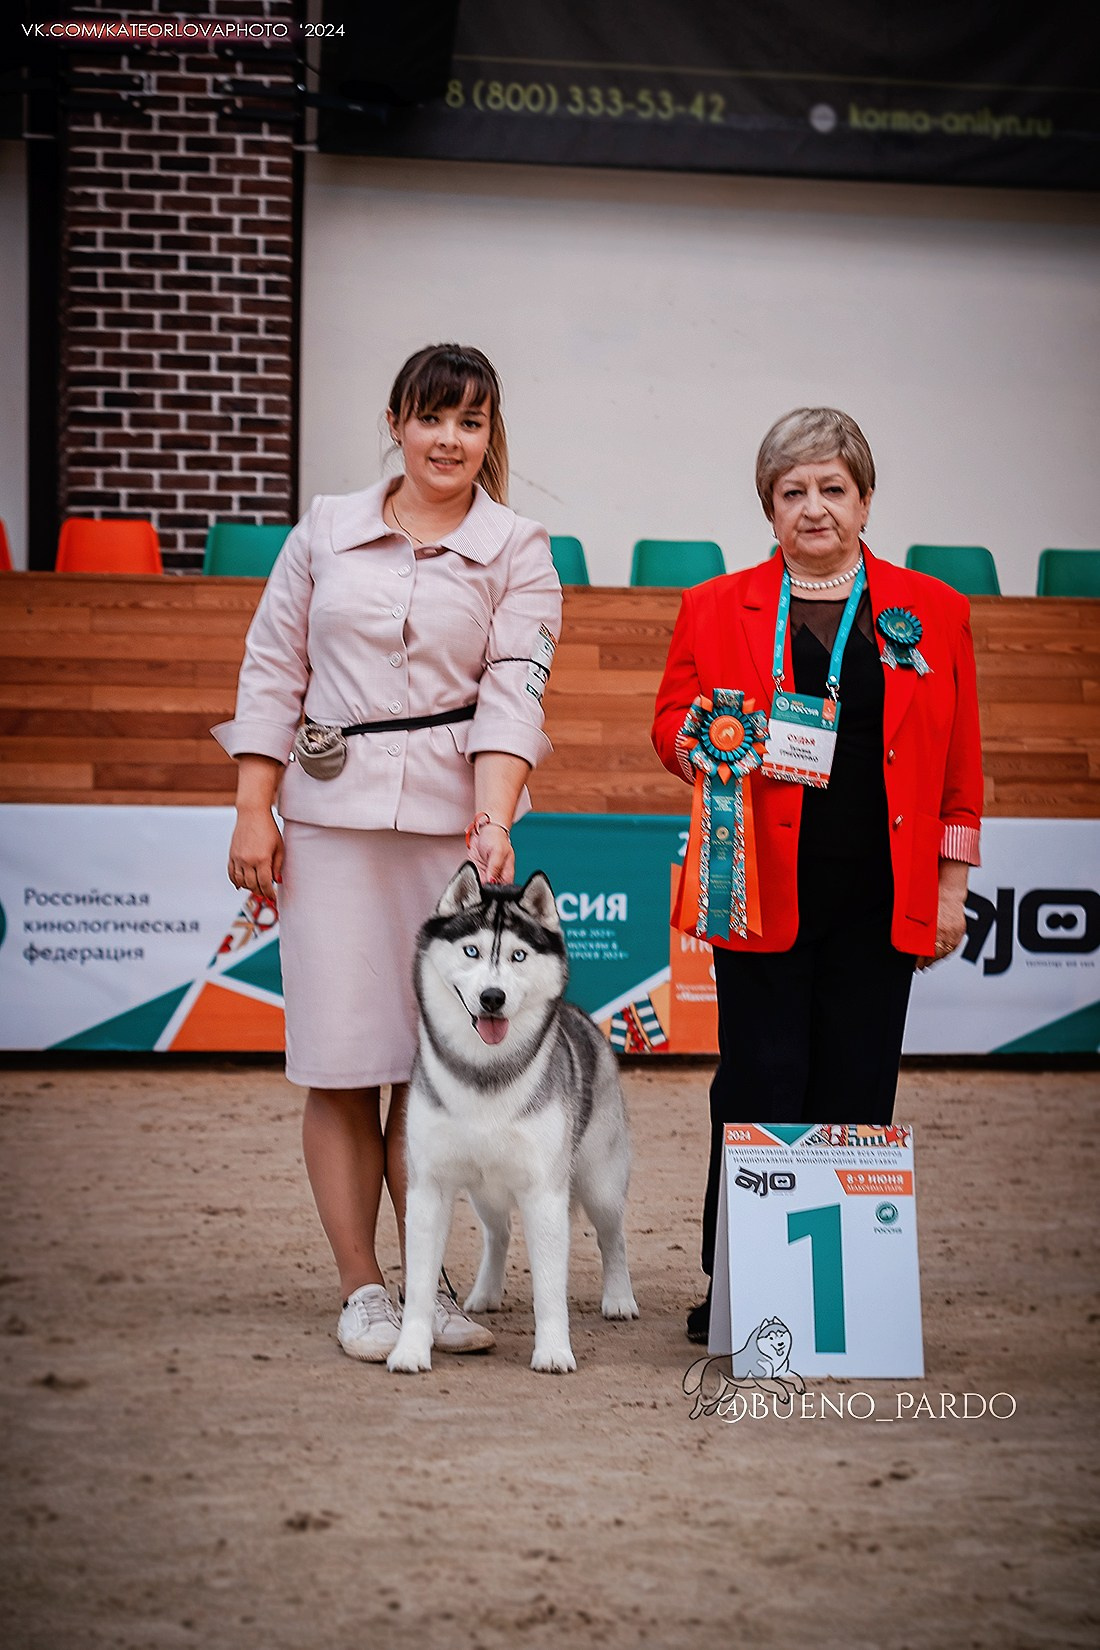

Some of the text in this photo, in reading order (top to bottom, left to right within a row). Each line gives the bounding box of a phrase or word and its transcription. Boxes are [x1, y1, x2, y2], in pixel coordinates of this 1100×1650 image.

[446, 80, 727, 124] 8 (800) 333-53-42
[24, 887, 150, 908] Российская
[23, 916, 200, 936] кинологическая
[23, 942, 144, 965] федерация
[726, 1129, 752, 1141] 2024
[868, 1175, 904, 1186] ИЮНЯ
[787, 1204, 846, 1354] 1
